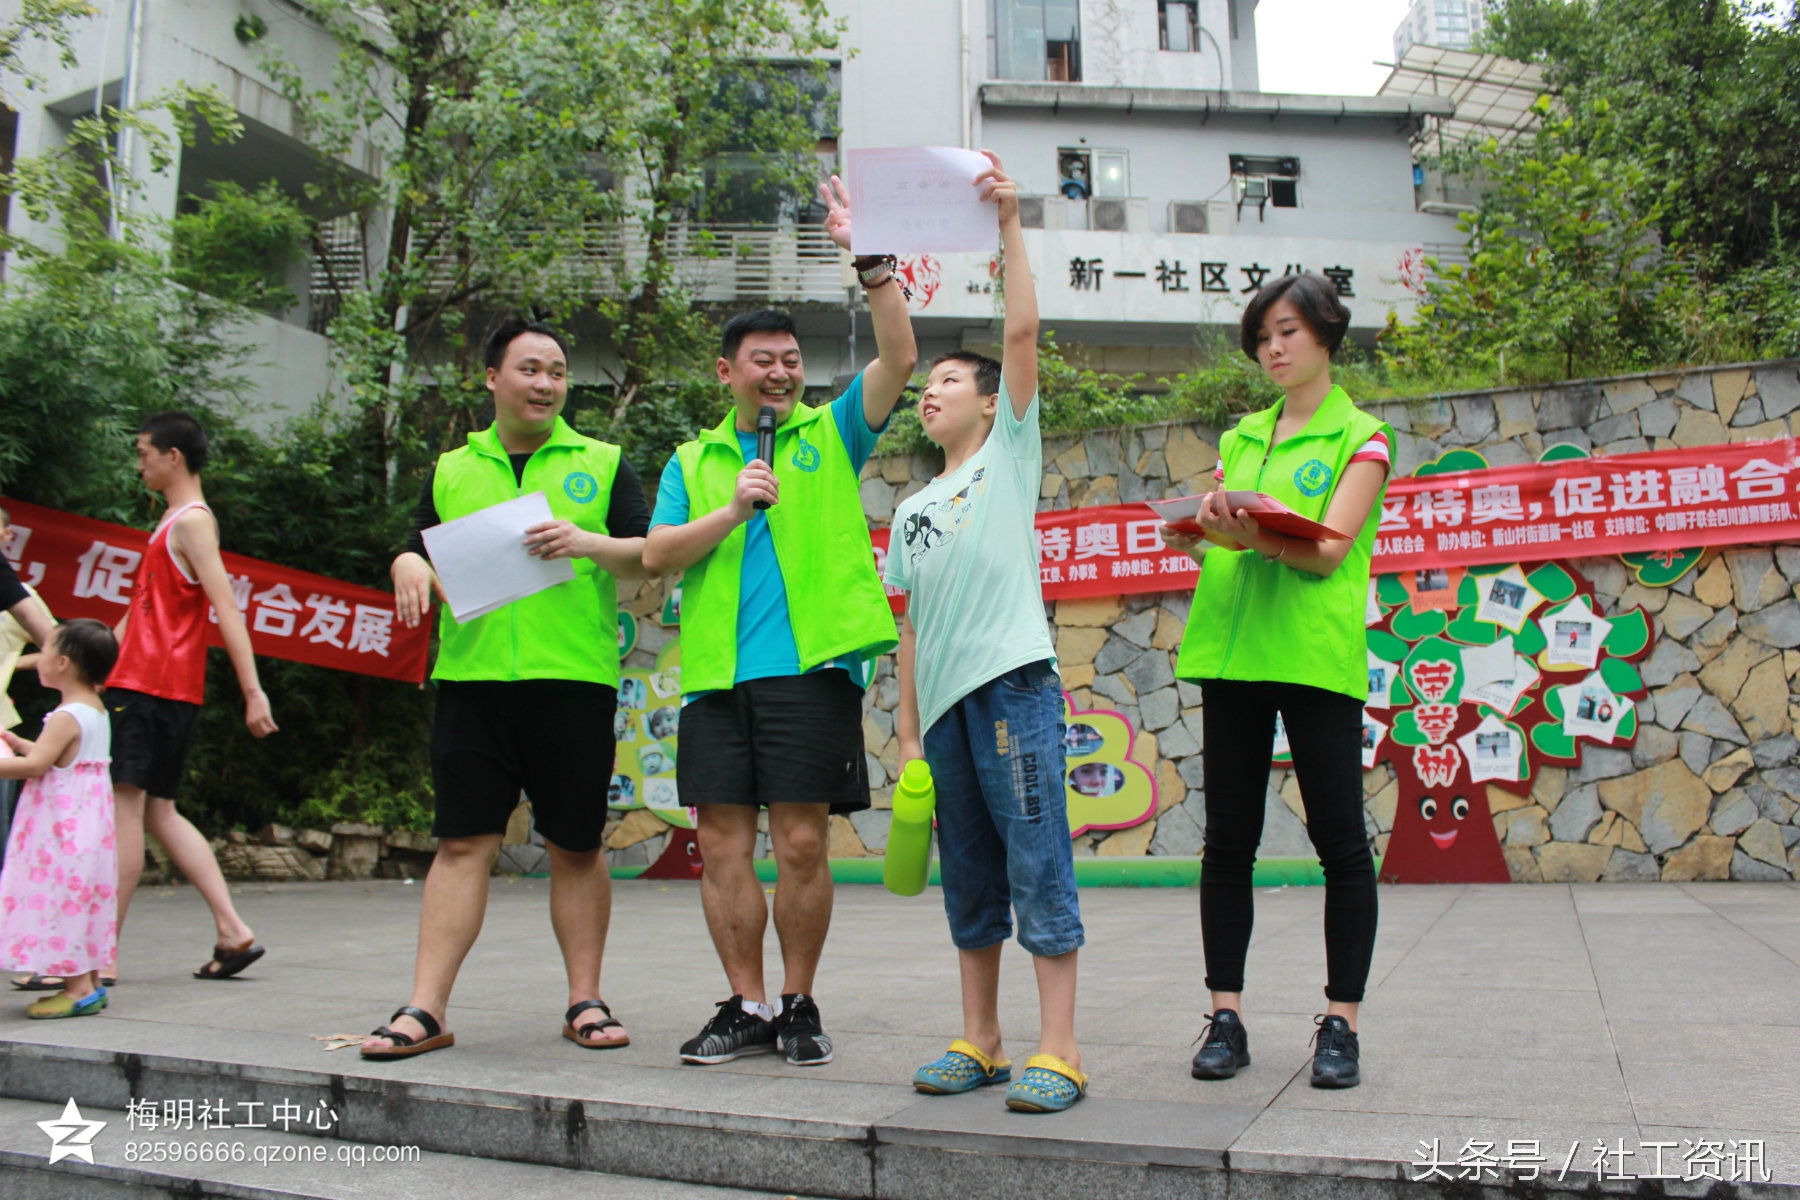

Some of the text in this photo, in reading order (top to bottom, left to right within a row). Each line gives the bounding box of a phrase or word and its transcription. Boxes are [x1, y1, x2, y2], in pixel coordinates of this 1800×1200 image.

[1378, 456, 1800, 533] 区特奥，促进融合
[1412, 660, 1461, 787] 荣誉树
[1023, 752, 1042, 825] COOL BOY
